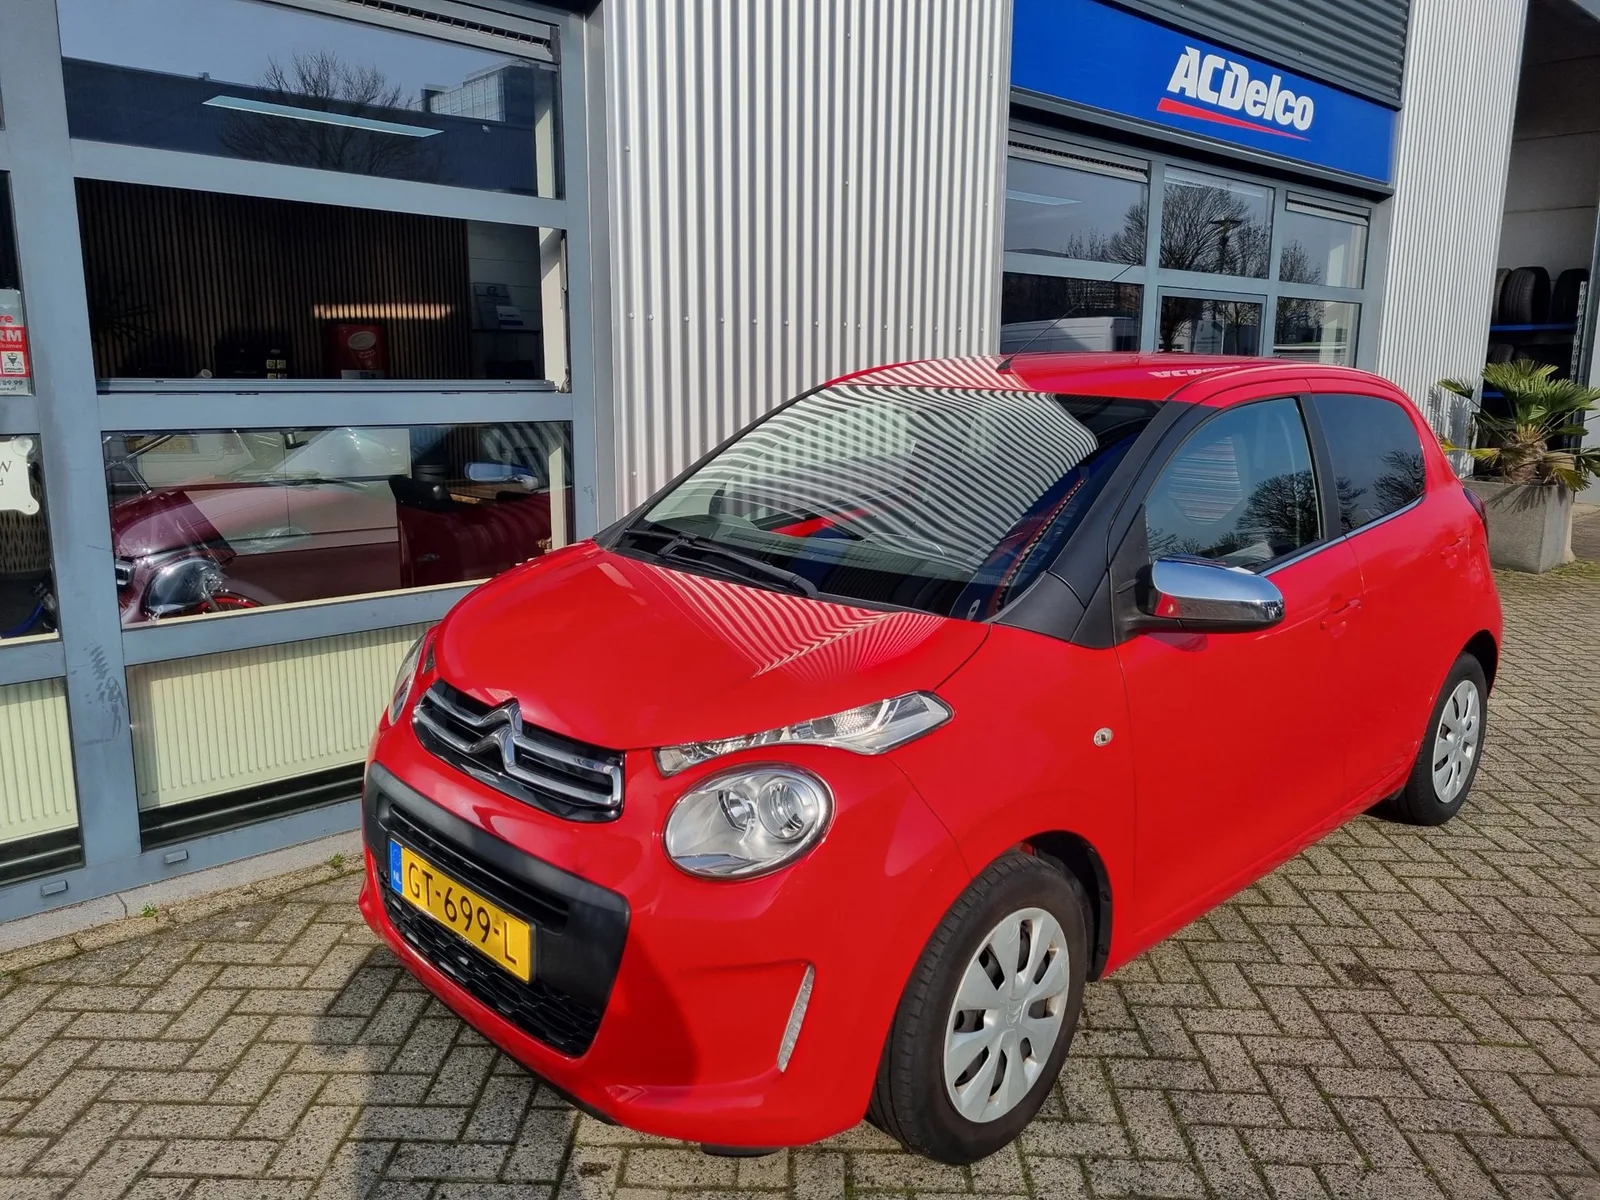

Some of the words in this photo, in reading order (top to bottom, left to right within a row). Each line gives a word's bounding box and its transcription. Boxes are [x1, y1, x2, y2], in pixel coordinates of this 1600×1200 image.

[1166, 45, 1314, 131] ACDelco
[393, 869, 402, 885] NL
[408, 862, 518, 966] GT-699-L
